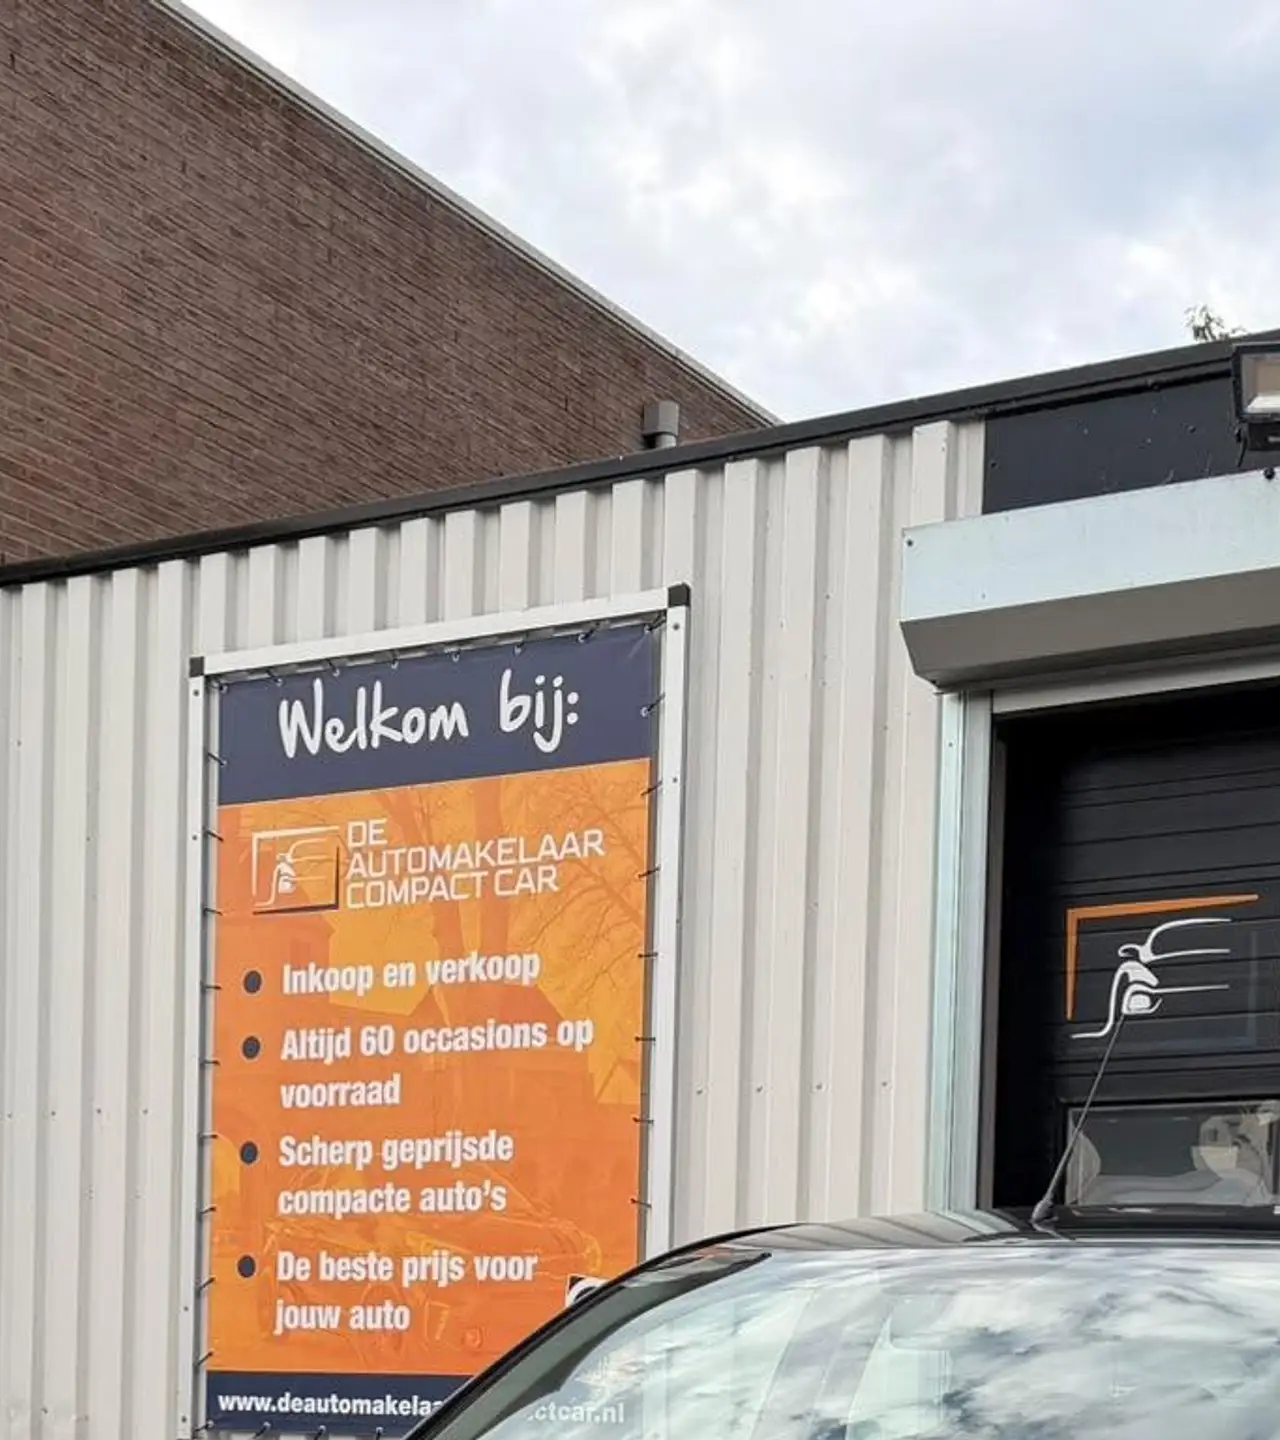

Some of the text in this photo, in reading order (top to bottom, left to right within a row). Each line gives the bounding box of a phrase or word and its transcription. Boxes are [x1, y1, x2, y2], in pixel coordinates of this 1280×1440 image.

[278, 669, 580, 758] Welkom bij:
[346, 818, 388, 848] DE
[346, 829, 605, 880] AUTOMAKELAAR
[347, 864, 560, 909] COMPACT CAR
[282, 951, 541, 997] Inkoop en verkoop
[280, 1018, 595, 1064] Altijd 60 occasions op
[280, 1074, 402, 1109] voorraad
[278, 1130, 515, 1170] Scherp geprijsde
[278, 1180, 508, 1220] compacte auto's
[276, 1251, 540, 1288] De beste prijs voor
[272, 1298, 411, 1336] jouw auto
